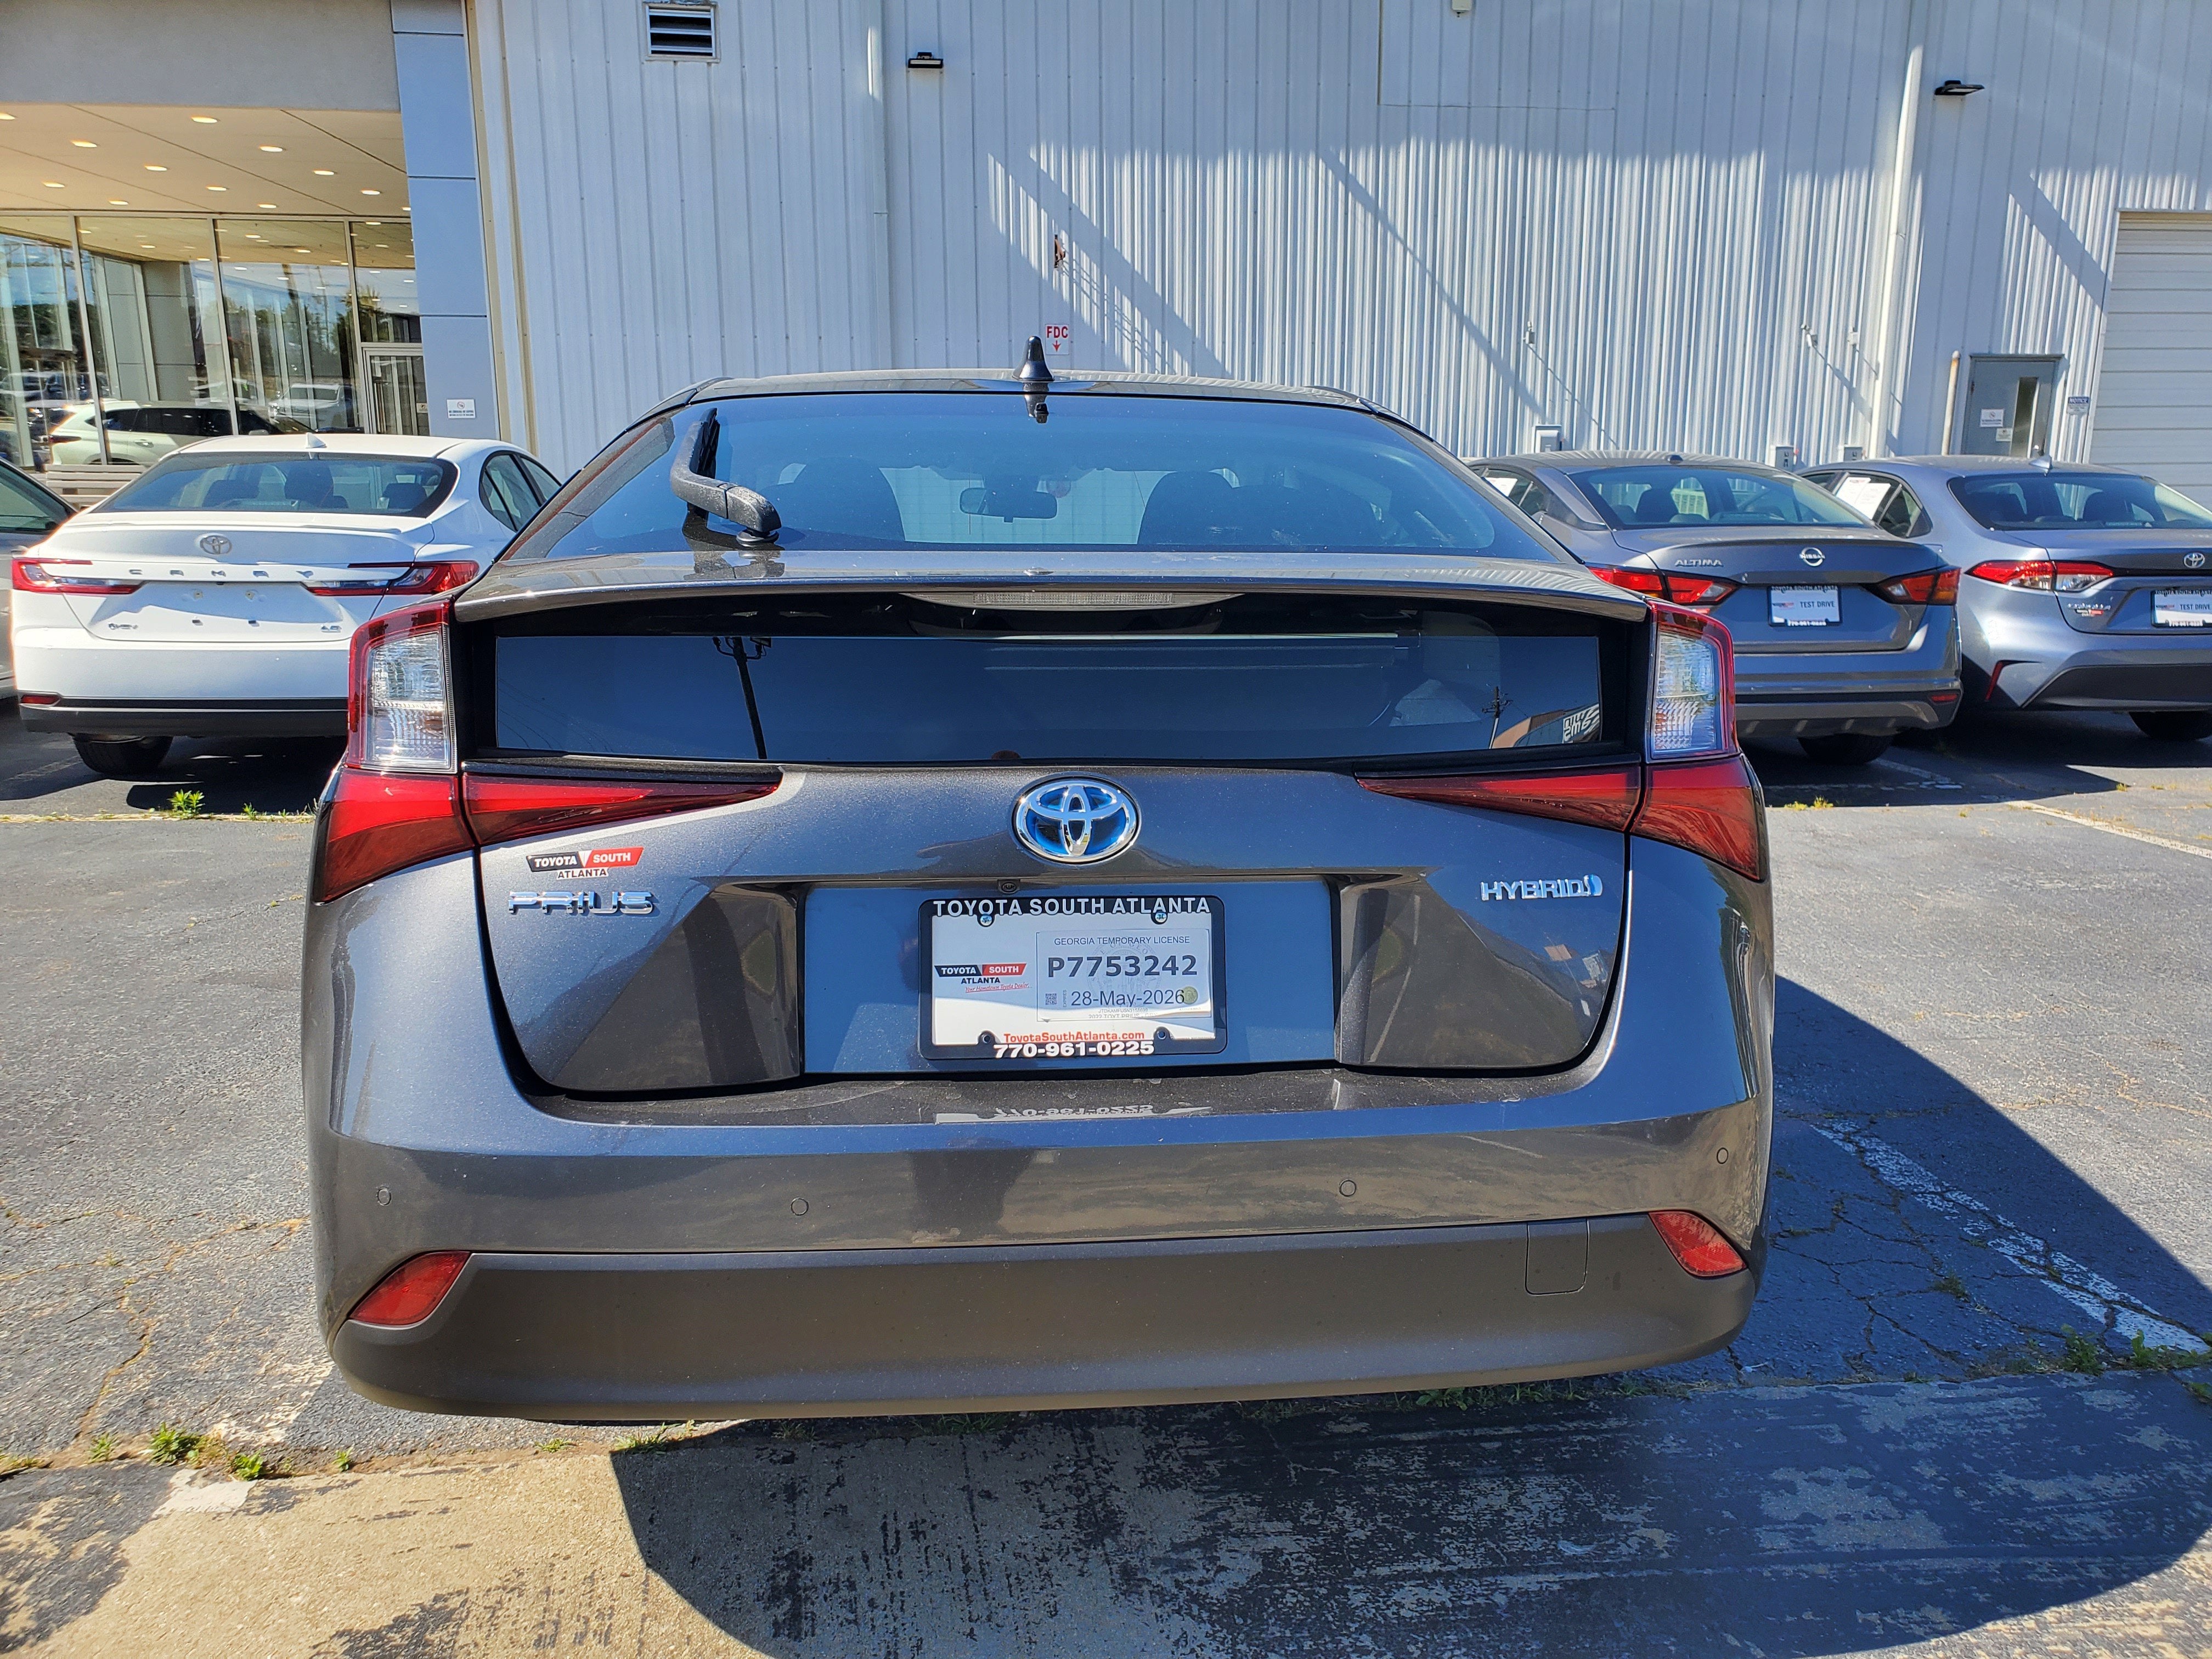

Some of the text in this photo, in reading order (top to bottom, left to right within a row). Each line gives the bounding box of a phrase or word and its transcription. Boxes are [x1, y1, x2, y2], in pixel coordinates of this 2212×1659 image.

[1047, 326, 1068, 338] FDC
[129, 569, 313, 578] CAMRY
[534, 853, 630, 867] TOYOTA SOUTH
[558, 868, 607, 878] ATLANTA
[1480, 879, 1587, 901] HYBRID
[509, 891, 653, 914] PRIUS
[933, 897, 1210, 917] TOYOTA SOUTH ATLANTA
[1048, 955, 1197, 977] P7753242
[1071, 990, 1184, 1007] 28-May-2026
[1004, 1031, 1144, 1043] ToyotaSouthAtlanta.com
[994, 1041, 1154, 1058] 770-961-0225
